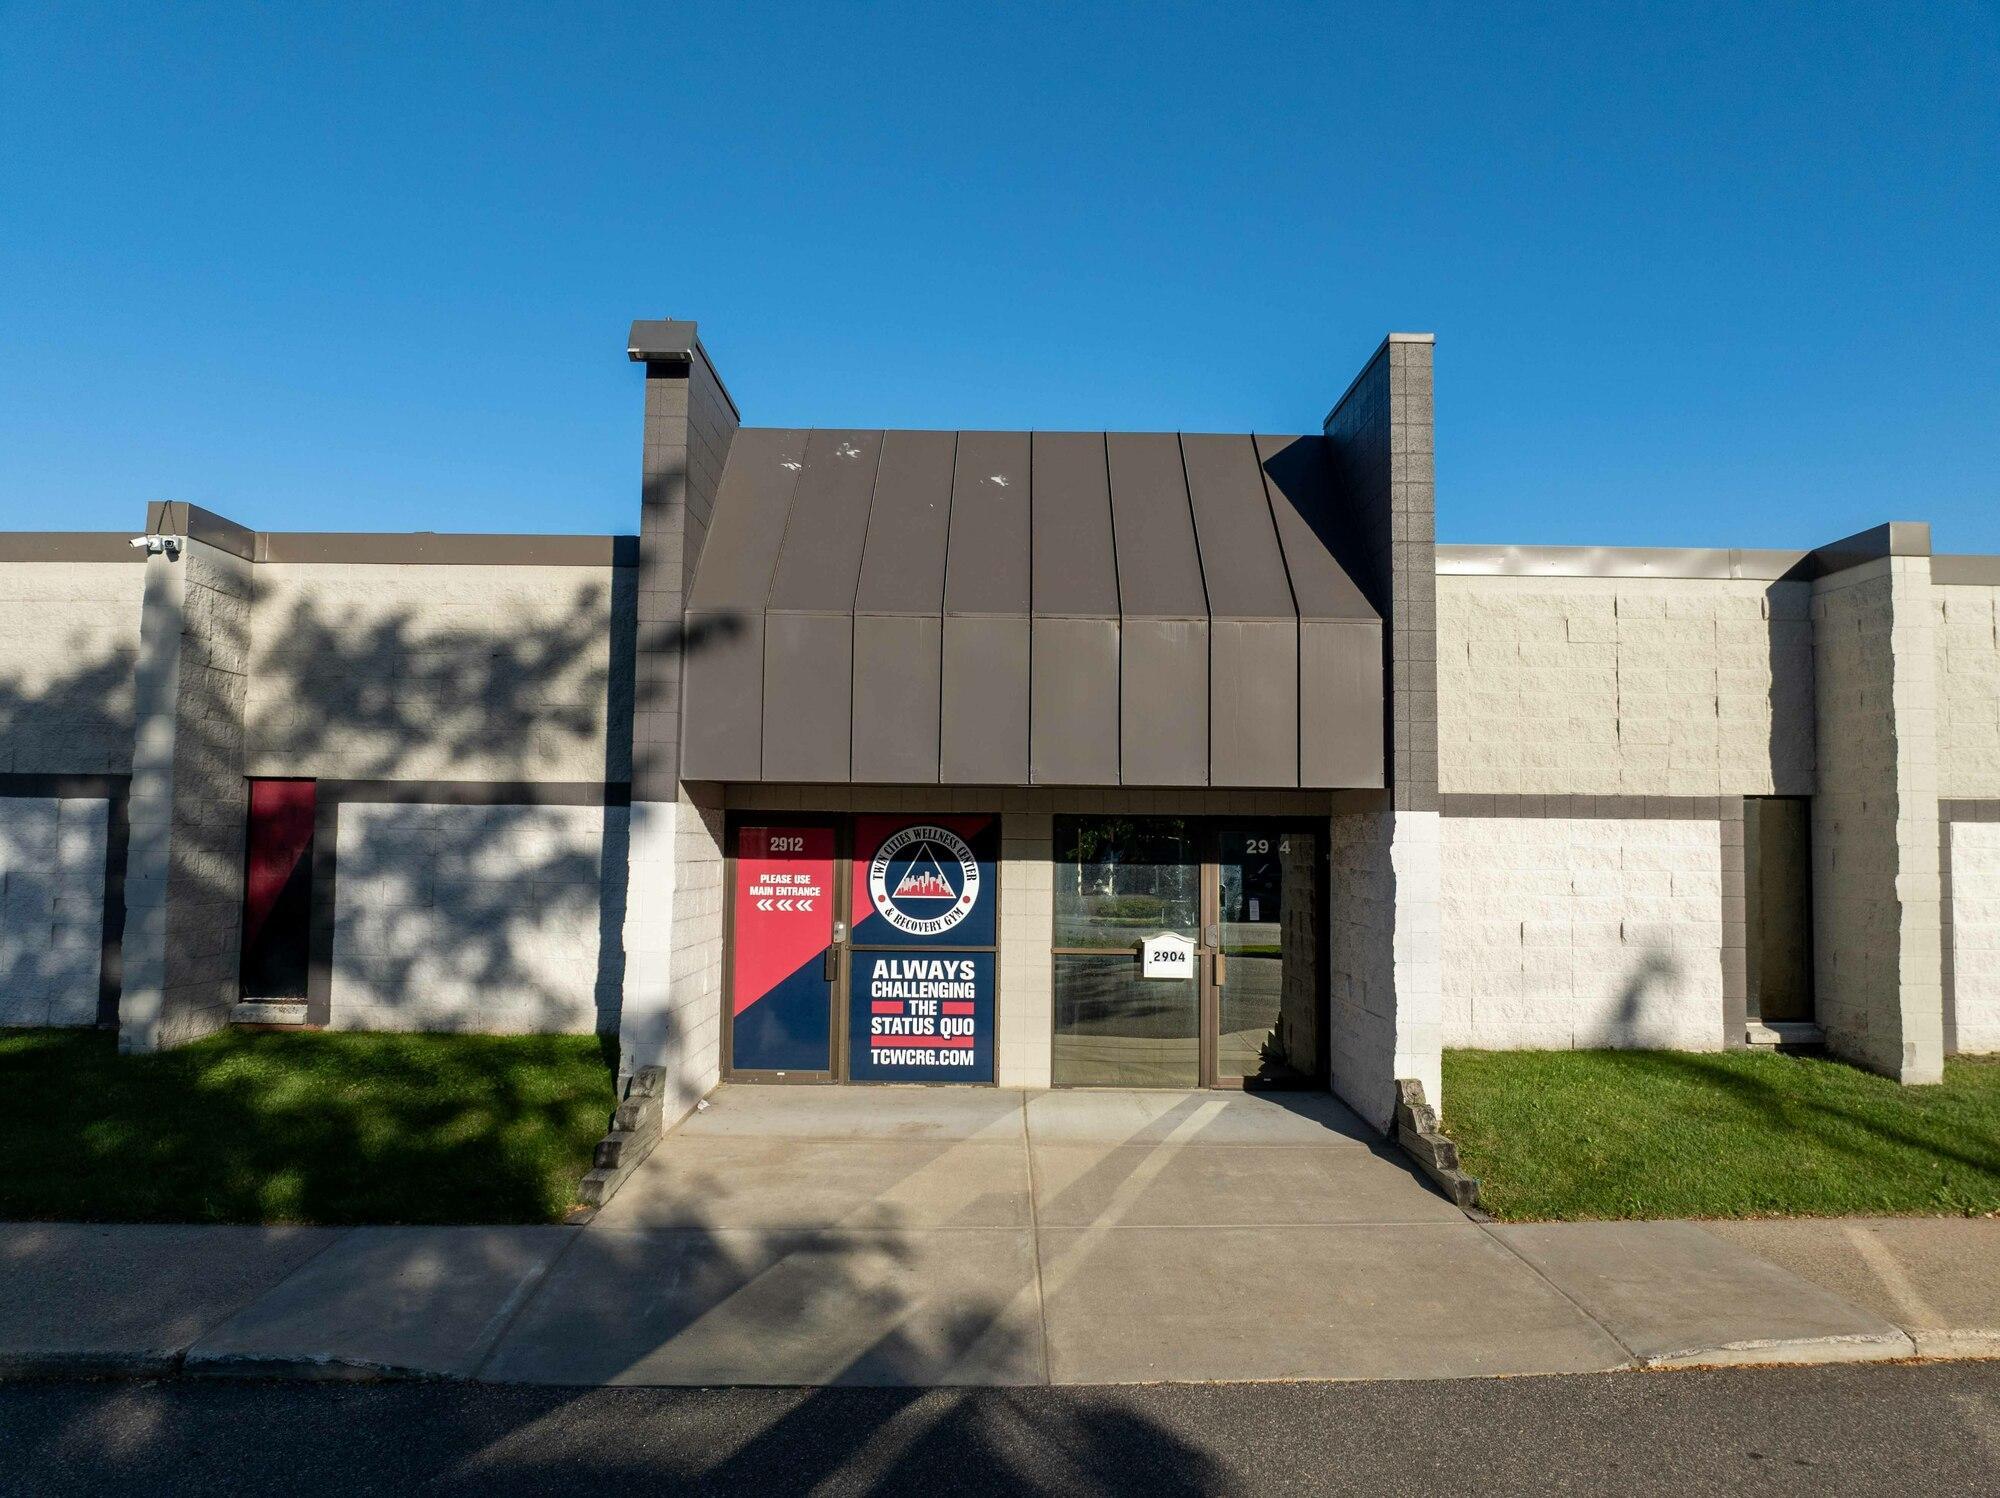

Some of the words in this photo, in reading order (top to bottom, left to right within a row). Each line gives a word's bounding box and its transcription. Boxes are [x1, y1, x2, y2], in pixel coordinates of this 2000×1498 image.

[770, 837, 804, 852] 2912
[1246, 839, 1291, 854] 294
[873, 855, 888, 880] TWIN
[883, 832, 911, 856] CITIES
[913, 828, 958, 850] WELLNESS
[956, 848, 977, 881] CENTER
[760, 874, 792, 884] PLEASE
[794, 874, 811, 884] USE
[749, 886, 773, 896] MAIN
[776, 886, 821, 896] ENTRANCE
[885, 907, 894, 917] &
[893, 914, 942, 932] RECOVERY
[944, 907, 965, 926] GYM
[1153, 951, 1186, 962] 2904
[872, 960, 975, 980] ALWAYS
[871, 981, 975, 999] CHALLENGING
[909, 1000, 937, 1016] THE
[871, 1017, 935, 1035] STATUS
[940, 1018, 975, 1039] QUO
[871, 1049, 974, 1066] TCWCRG.COM
